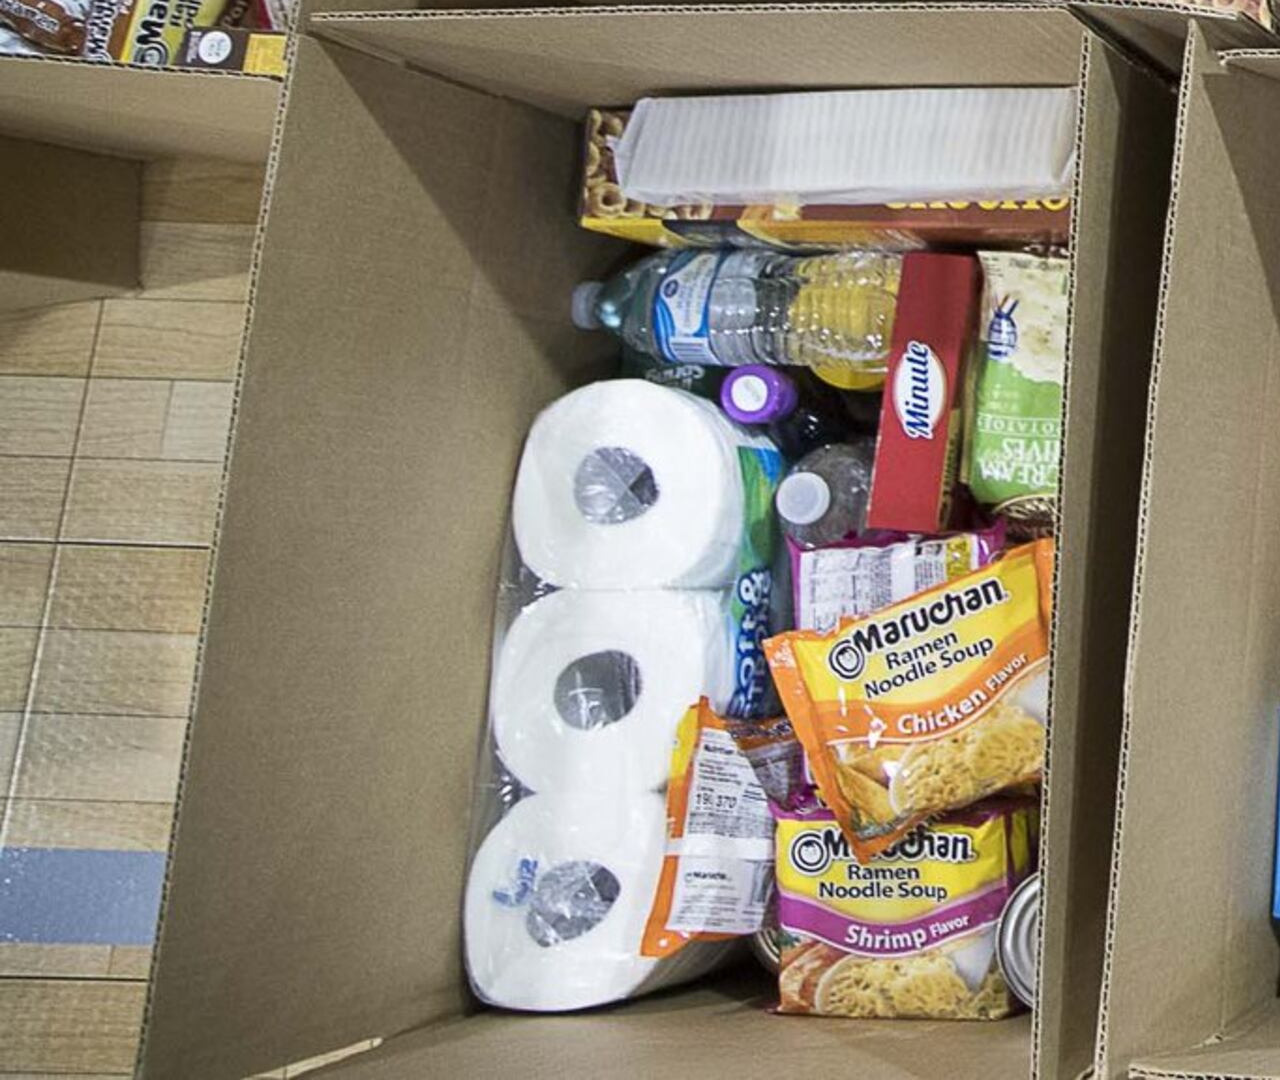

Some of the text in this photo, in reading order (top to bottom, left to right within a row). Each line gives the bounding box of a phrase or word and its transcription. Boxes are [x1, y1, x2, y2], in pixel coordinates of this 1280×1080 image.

[905, 341, 931, 438] Minute
[855, 579, 1003, 654] Maruchan
[864, 636, 994, 698] Noodle Soup
[885, 631, 958, 670] Ramen
[897, 653, 1028, 735] Chicken Flavor
[819, 882, 948, 902] Noodle Soup
[848, 864, 920, 880] Ramen
[845, 914, 970, 950] Shrimp Flavor
